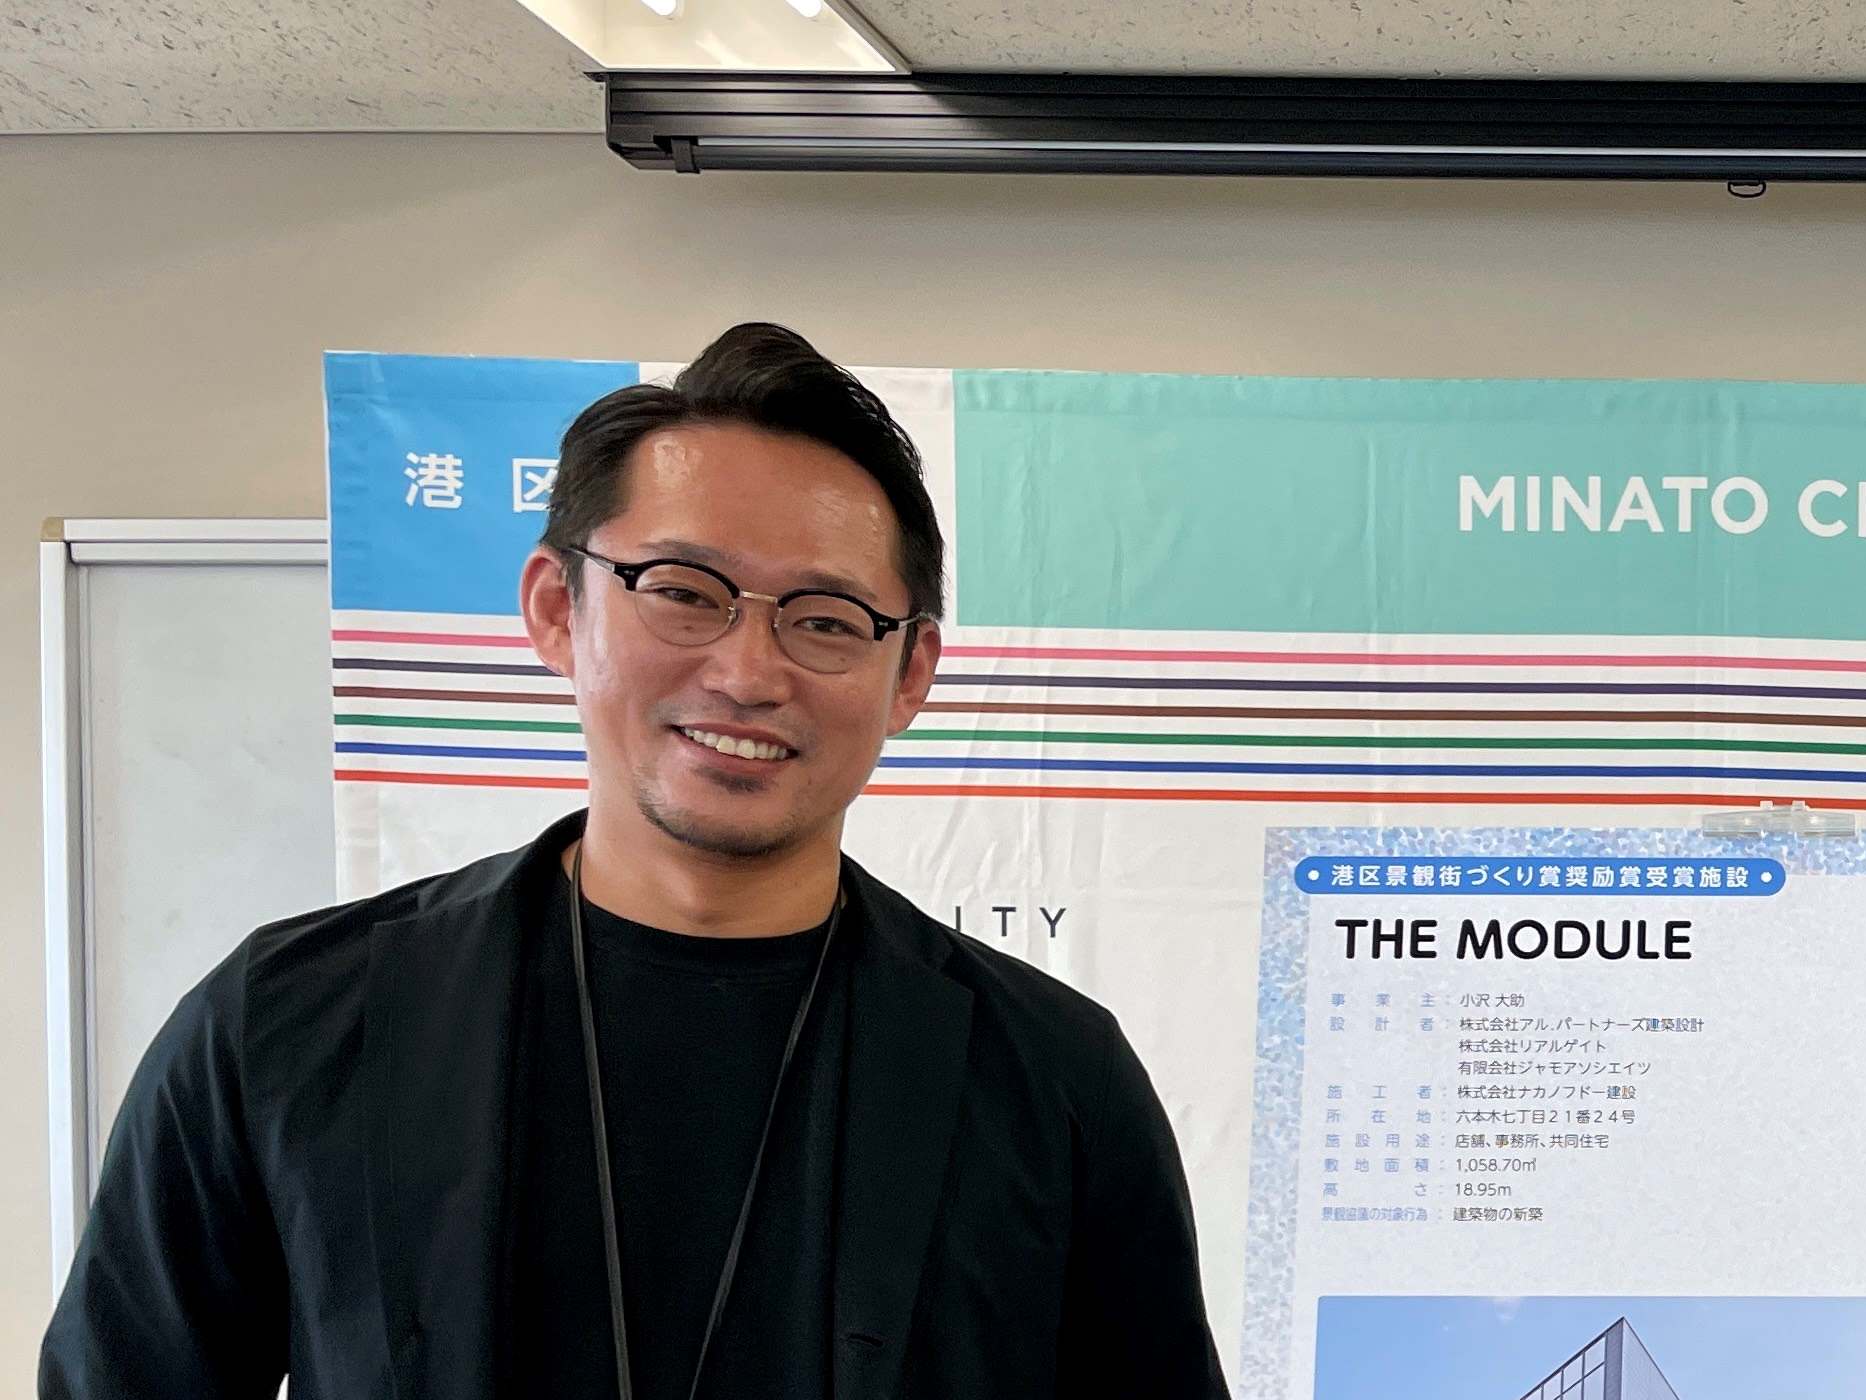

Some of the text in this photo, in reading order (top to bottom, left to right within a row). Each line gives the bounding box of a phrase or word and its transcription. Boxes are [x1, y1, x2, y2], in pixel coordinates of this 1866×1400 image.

[1459, 475, 1769, 534] MINATO
[1331, 864, 1750, 889] 港区景観街づくり賞奨励賞受賞施設
[955, 905, 1066, 938] ITY
[1335, 918, 1693, 960] THE MODULE
[1459, 1039, 1607, 1054] 株式会社リアルゲイト
[1455, 1182, 1512, 1196] 18.95m
